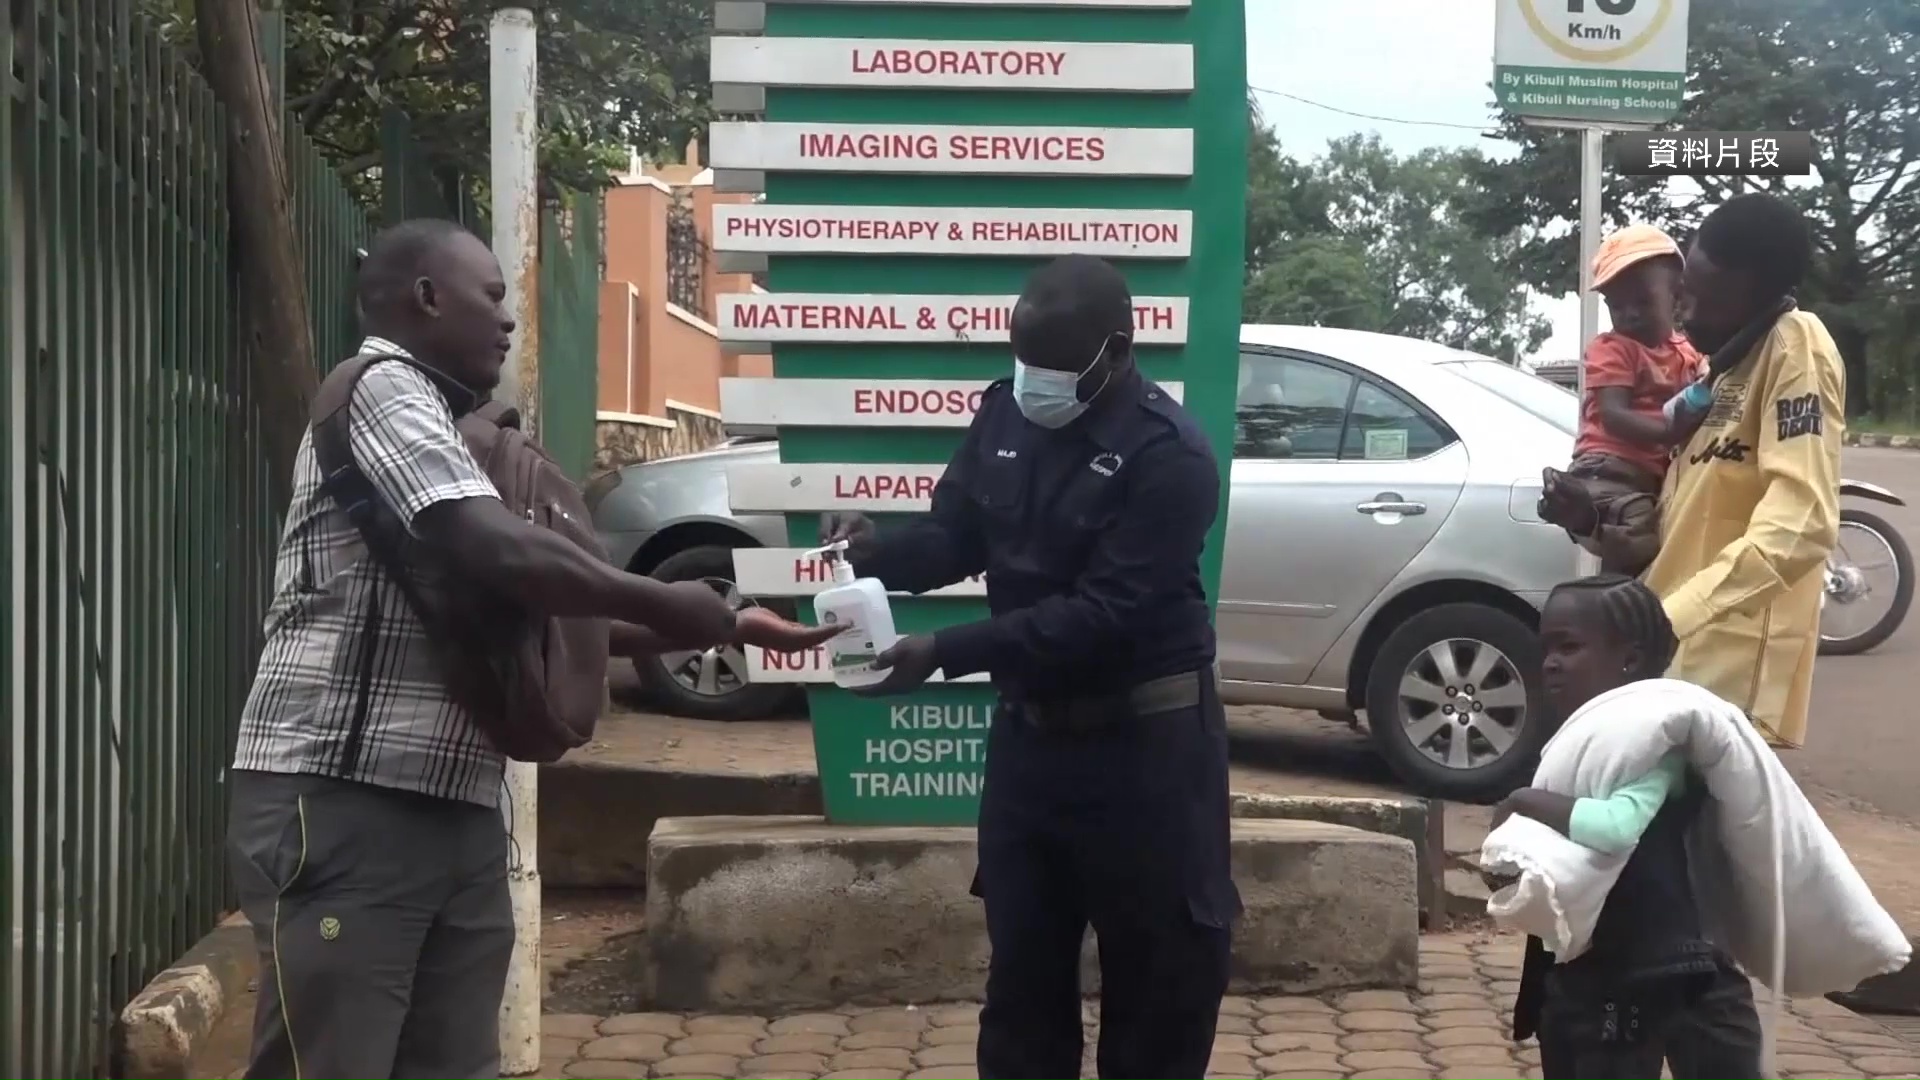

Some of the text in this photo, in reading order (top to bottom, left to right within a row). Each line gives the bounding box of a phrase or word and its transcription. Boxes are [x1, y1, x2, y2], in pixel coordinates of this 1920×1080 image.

[1568, 23, 1621, 40] Km/h
[852, 50, 1066, 75] LABORATORY
[1502, 72, 1678, 92] By Kibuli Muslim Hospital
[1507, 93, 1678, 110] & Kibuli Nursing Schools
[800, 134, 1105, 161] IMAGING SERVICES
[727, 218, 1178, 242] PHYSIOTHERAPY & REHABILITATION
[734, 304, 1173, 331] MATERNAL & CHIL TH
[855, 390, 982, 414] ENDOSC
[1776, 392, 1820, 421] ROYA
[834, 475, 933, 498] LAPAR
[763, 647, 825, 670] NUT
[890, 704, 992, 729] KIBULI
[865, 738, 986, 763] HOSPIT
